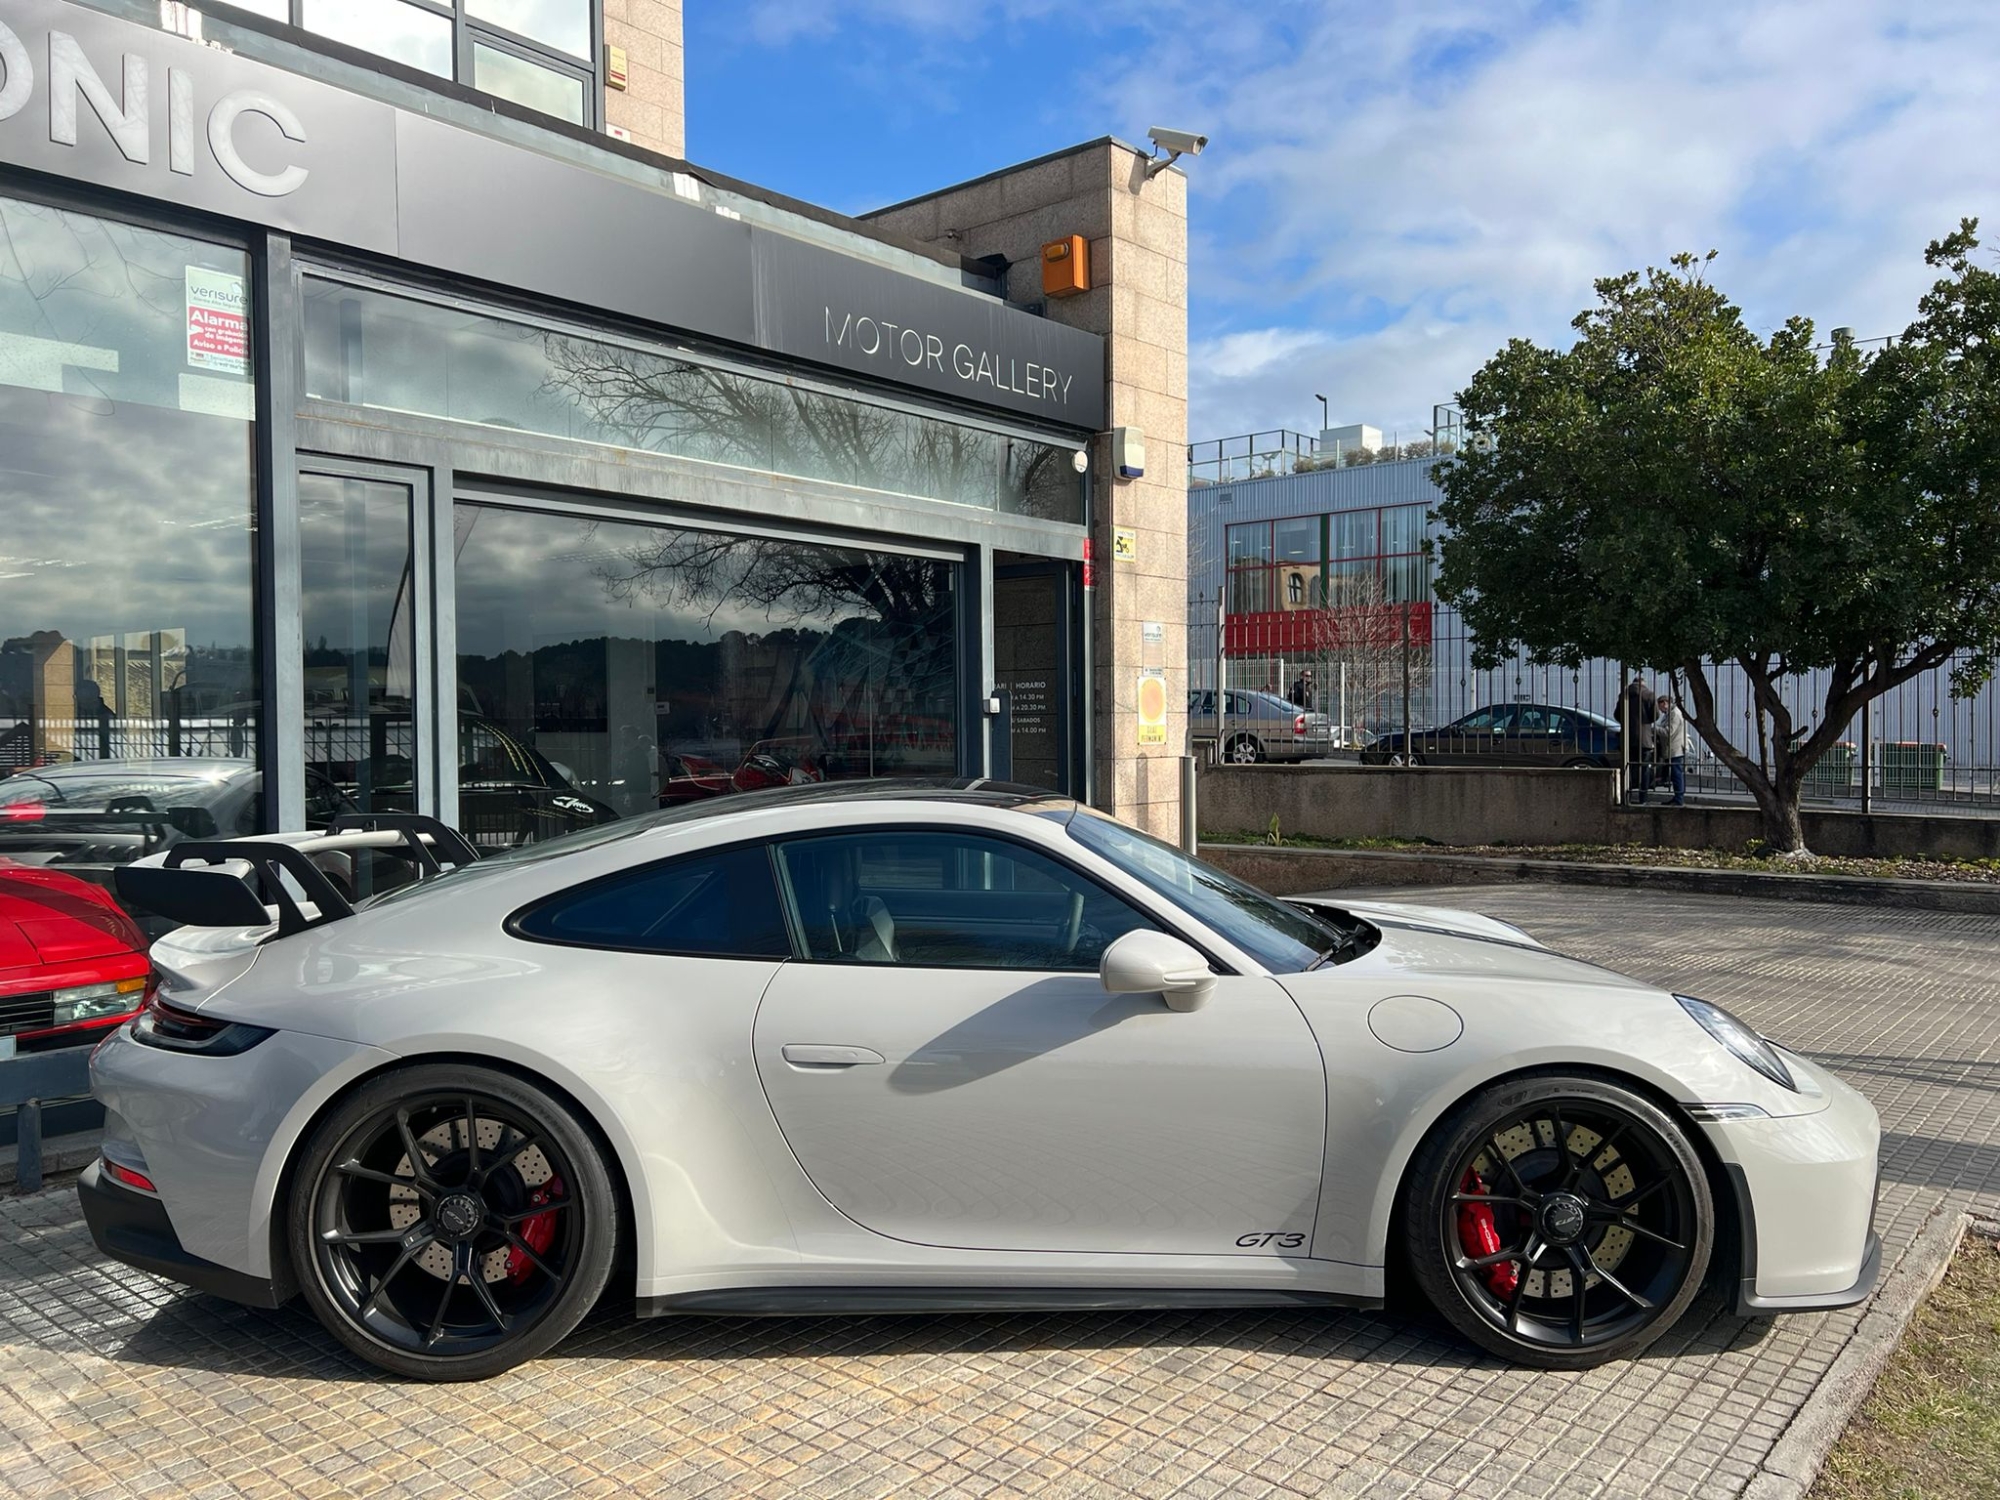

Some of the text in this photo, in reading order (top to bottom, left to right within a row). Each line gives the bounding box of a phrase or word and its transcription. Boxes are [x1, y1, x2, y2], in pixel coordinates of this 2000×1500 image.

[190, 286, 248, 305] verisure
[190, 310, 248, 330] Alarma
[193, 339, 215, 349] Aviso
[825, 306, 1072, 405] MOTOR GALLERY
[1015, 681, 1046, 689] HORARIO
[1235, 1232, 1307, 1249] GT3
